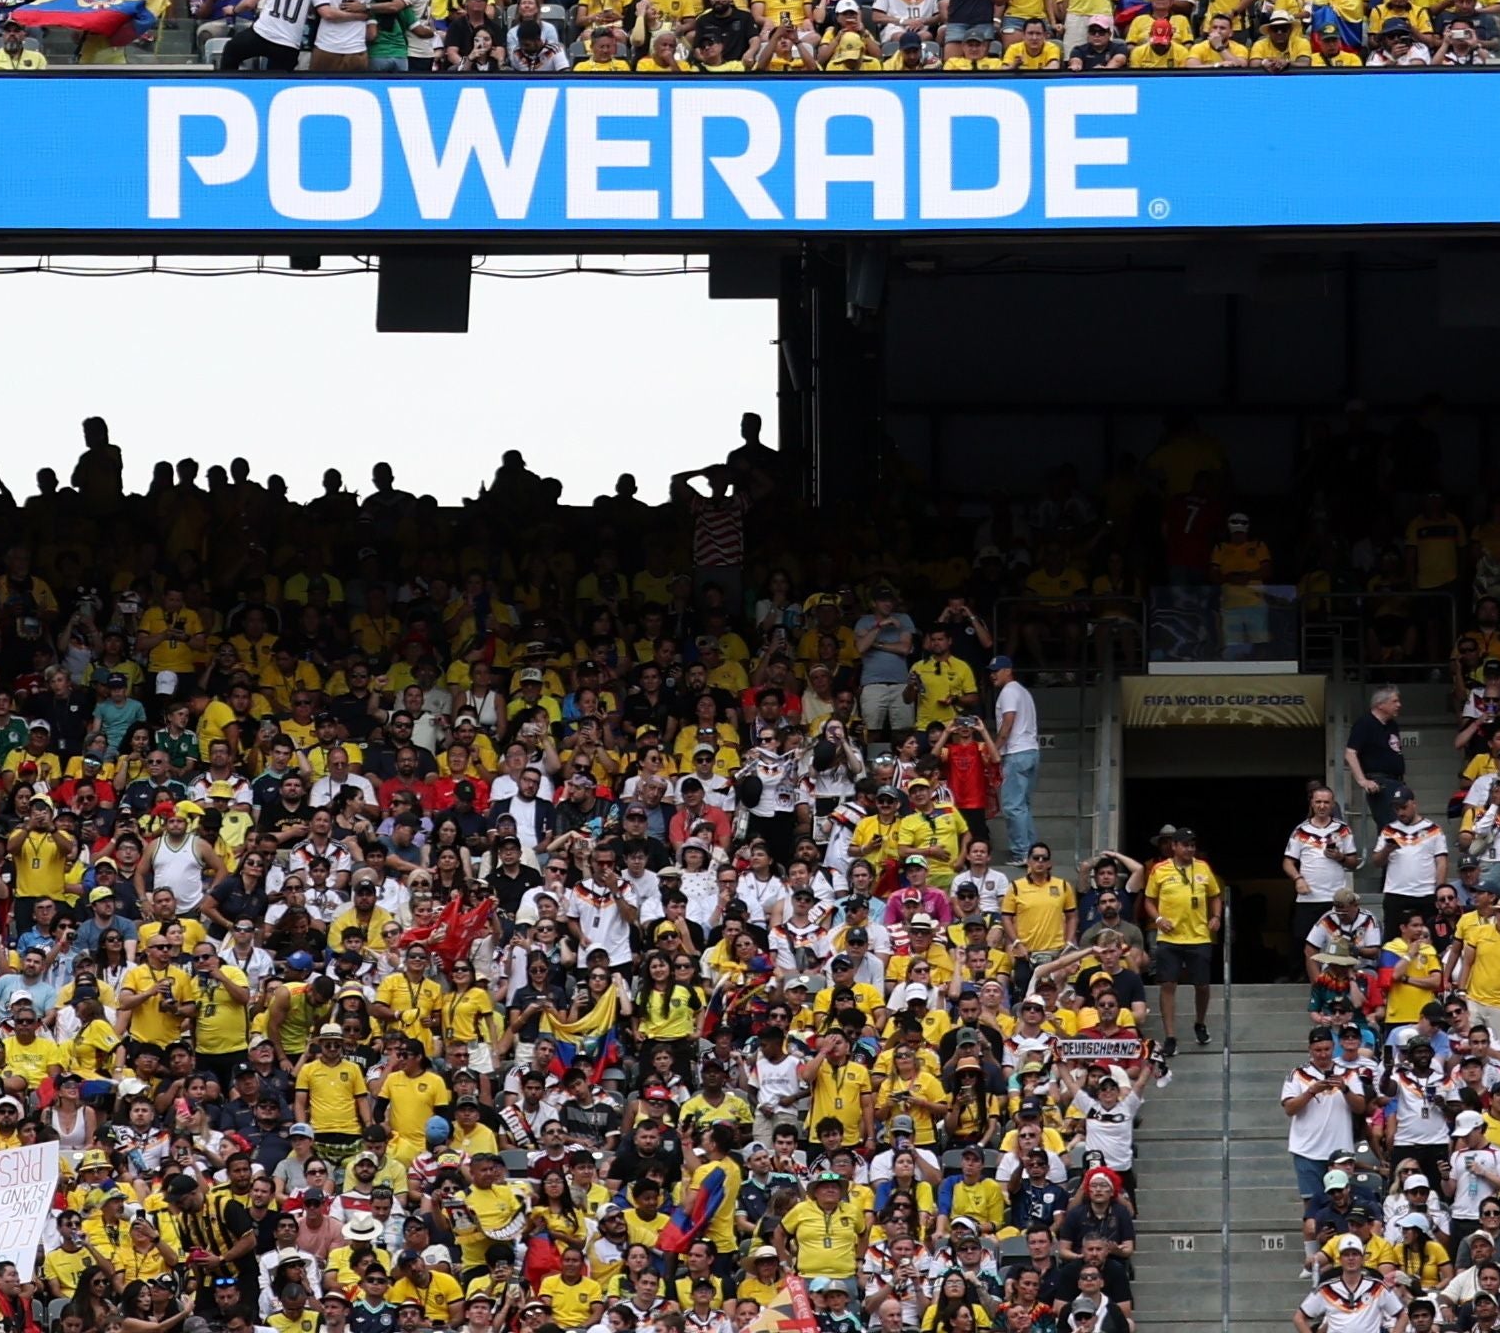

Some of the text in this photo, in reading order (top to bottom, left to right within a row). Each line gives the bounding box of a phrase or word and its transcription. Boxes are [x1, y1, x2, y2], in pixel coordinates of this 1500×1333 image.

[907, 7, 921, 20] 10
[1185, 505, 1200, 534] 7
[1143, 695, 1305, 706] FIFA WORLD CUP 2026
[1061, 1040, 1138, 1056] DEUTSCHLAND
[1171, 1237, 1194, 1251] 104
[1262, 1237, 1284, 1251] 106
